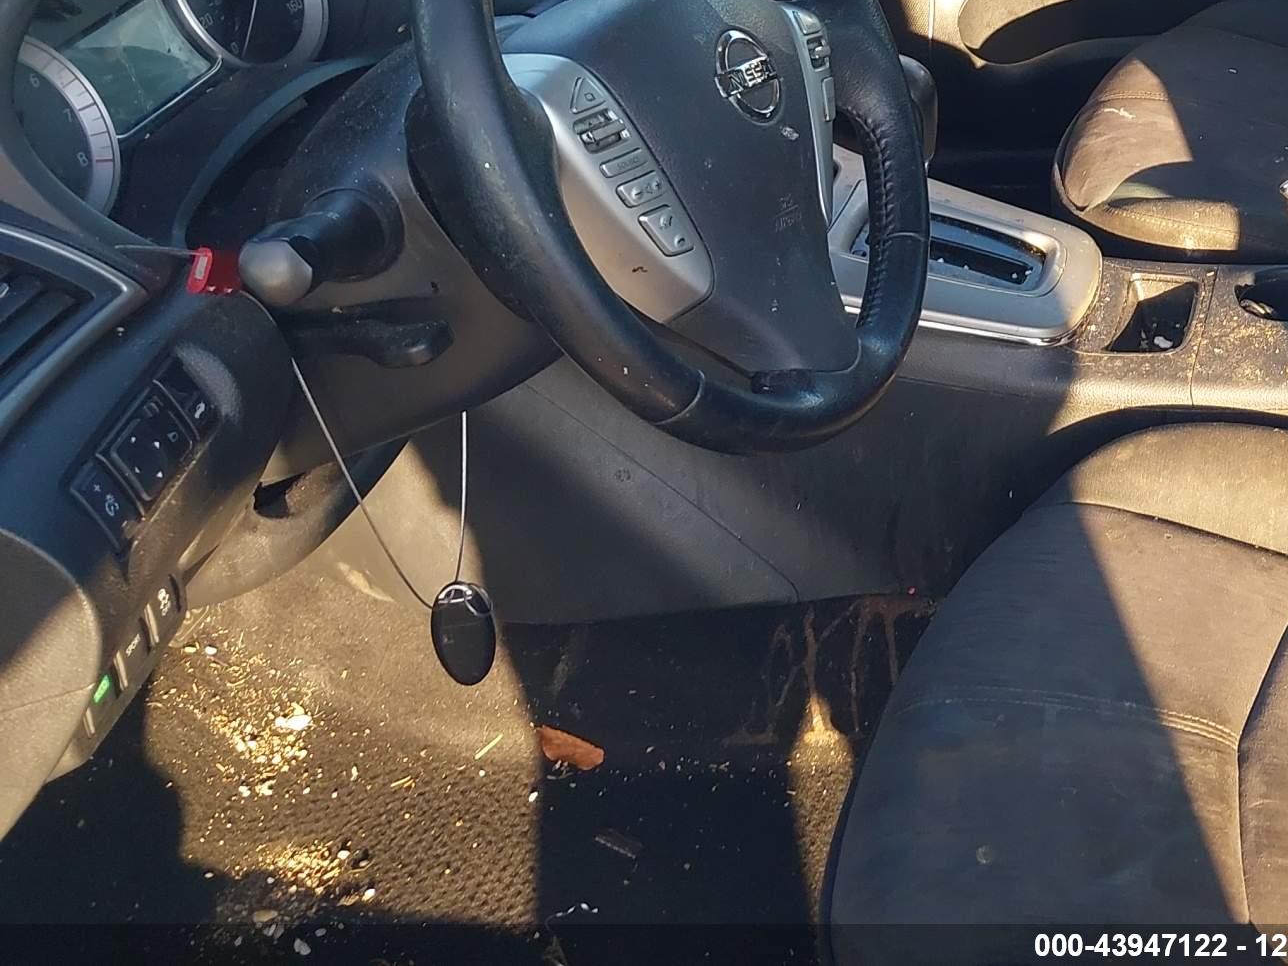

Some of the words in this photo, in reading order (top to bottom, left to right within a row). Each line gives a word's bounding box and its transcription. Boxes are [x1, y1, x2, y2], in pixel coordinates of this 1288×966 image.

[198, 12, 214, 28] 20
[229, 41, 240, 54] 0
[29, 74, 41, 88] 6
[63, 108, 73, 123] 7
[75, 151, 89, 167] 8
